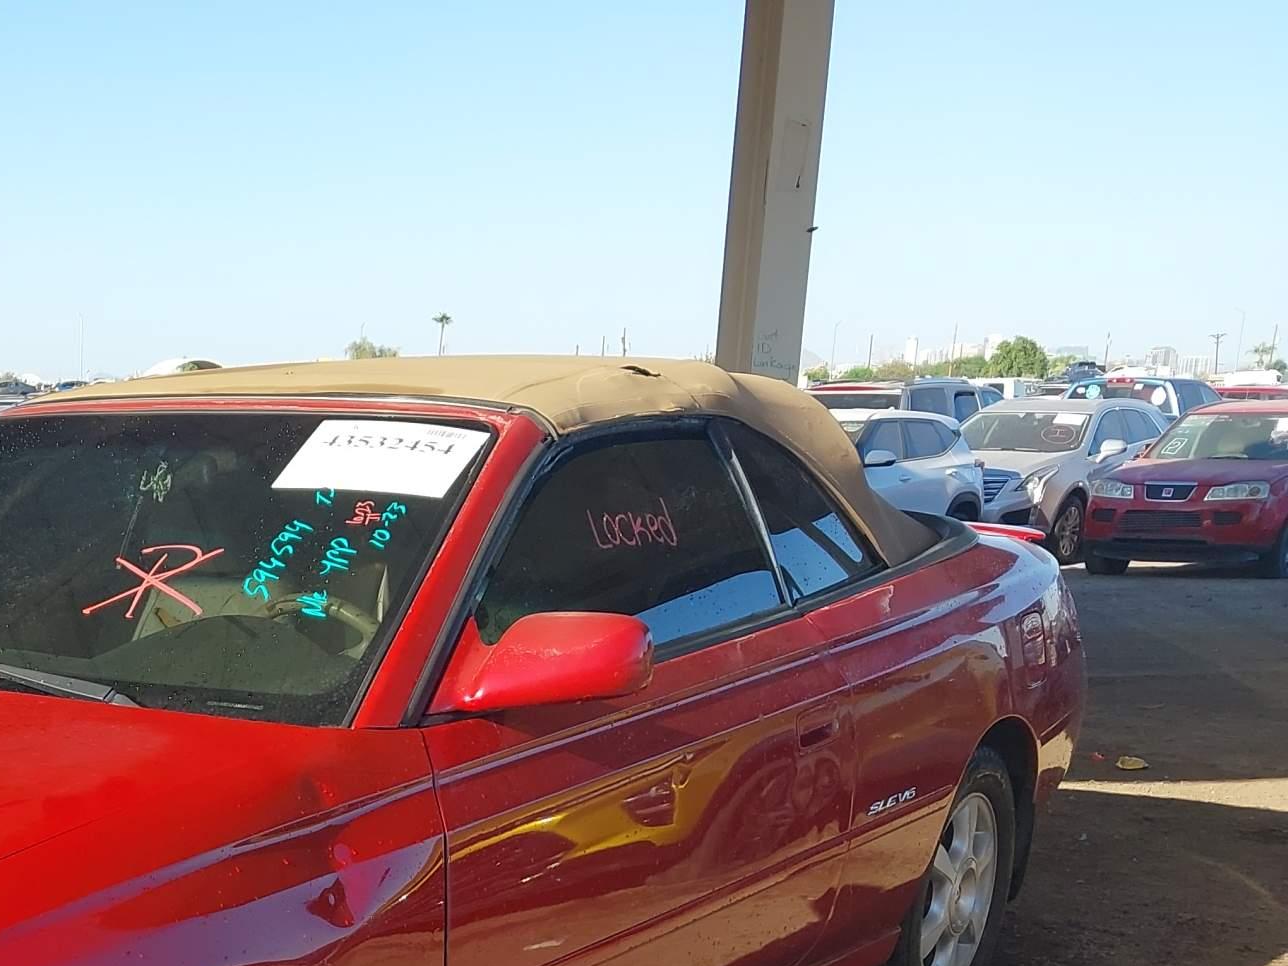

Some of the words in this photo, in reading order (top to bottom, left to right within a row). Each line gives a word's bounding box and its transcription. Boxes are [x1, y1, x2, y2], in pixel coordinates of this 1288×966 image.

[321, 434, 456, 455] 43532454
[866, 794, 898, 816] SLE
[897, 786, 917, 802] V6
